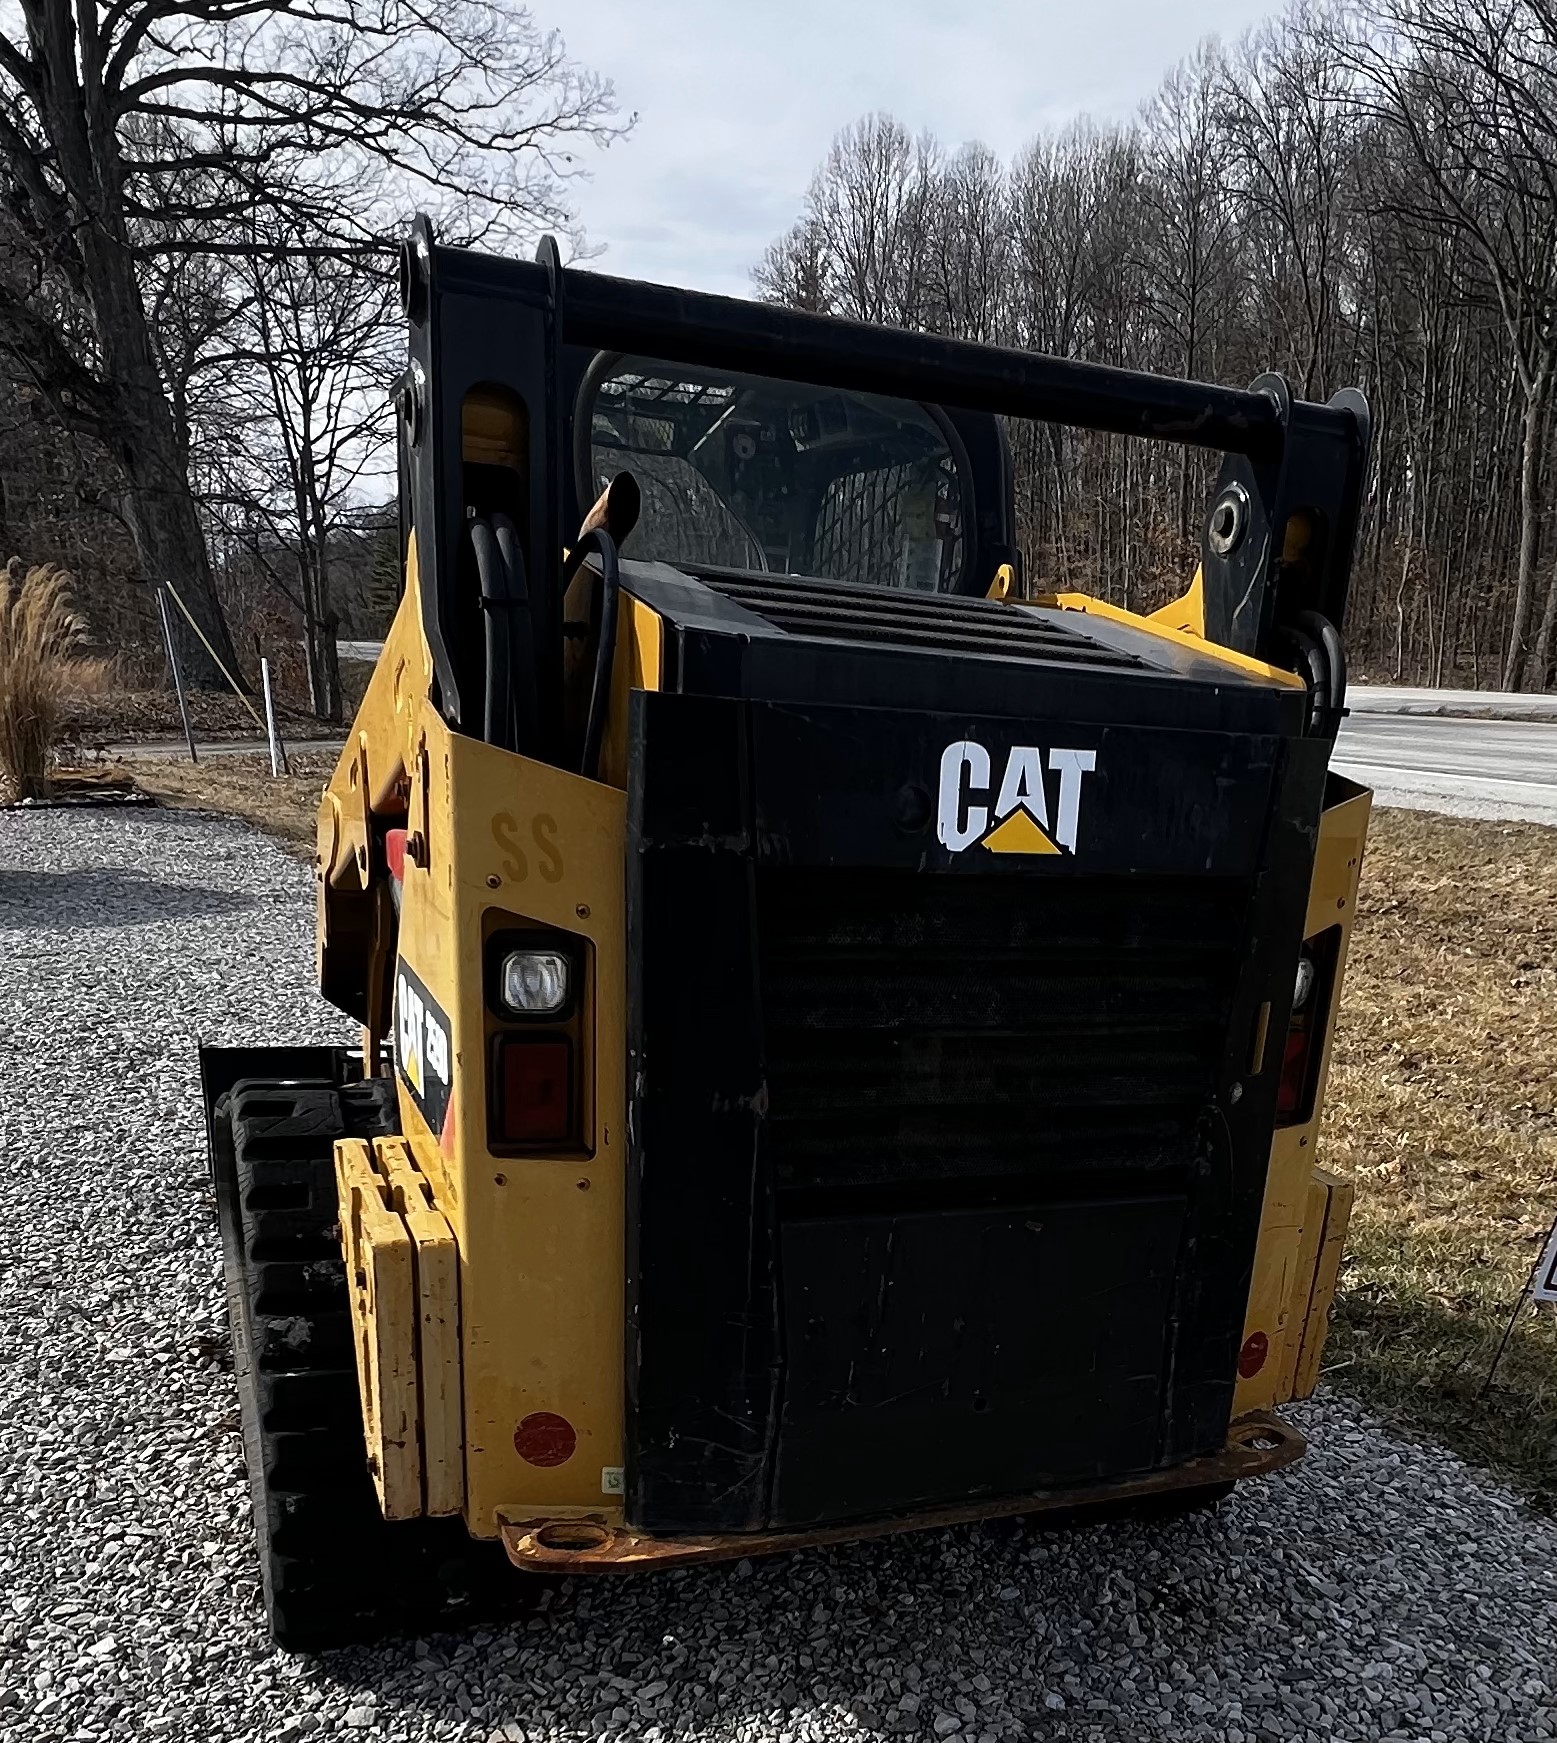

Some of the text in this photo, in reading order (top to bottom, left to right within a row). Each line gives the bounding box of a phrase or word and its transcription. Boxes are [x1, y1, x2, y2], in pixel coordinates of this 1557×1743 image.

[491, 811, 564, 884] SS
[937, 740, 1097, 856] CAT
[398, 973, 425, 1099] CAT
